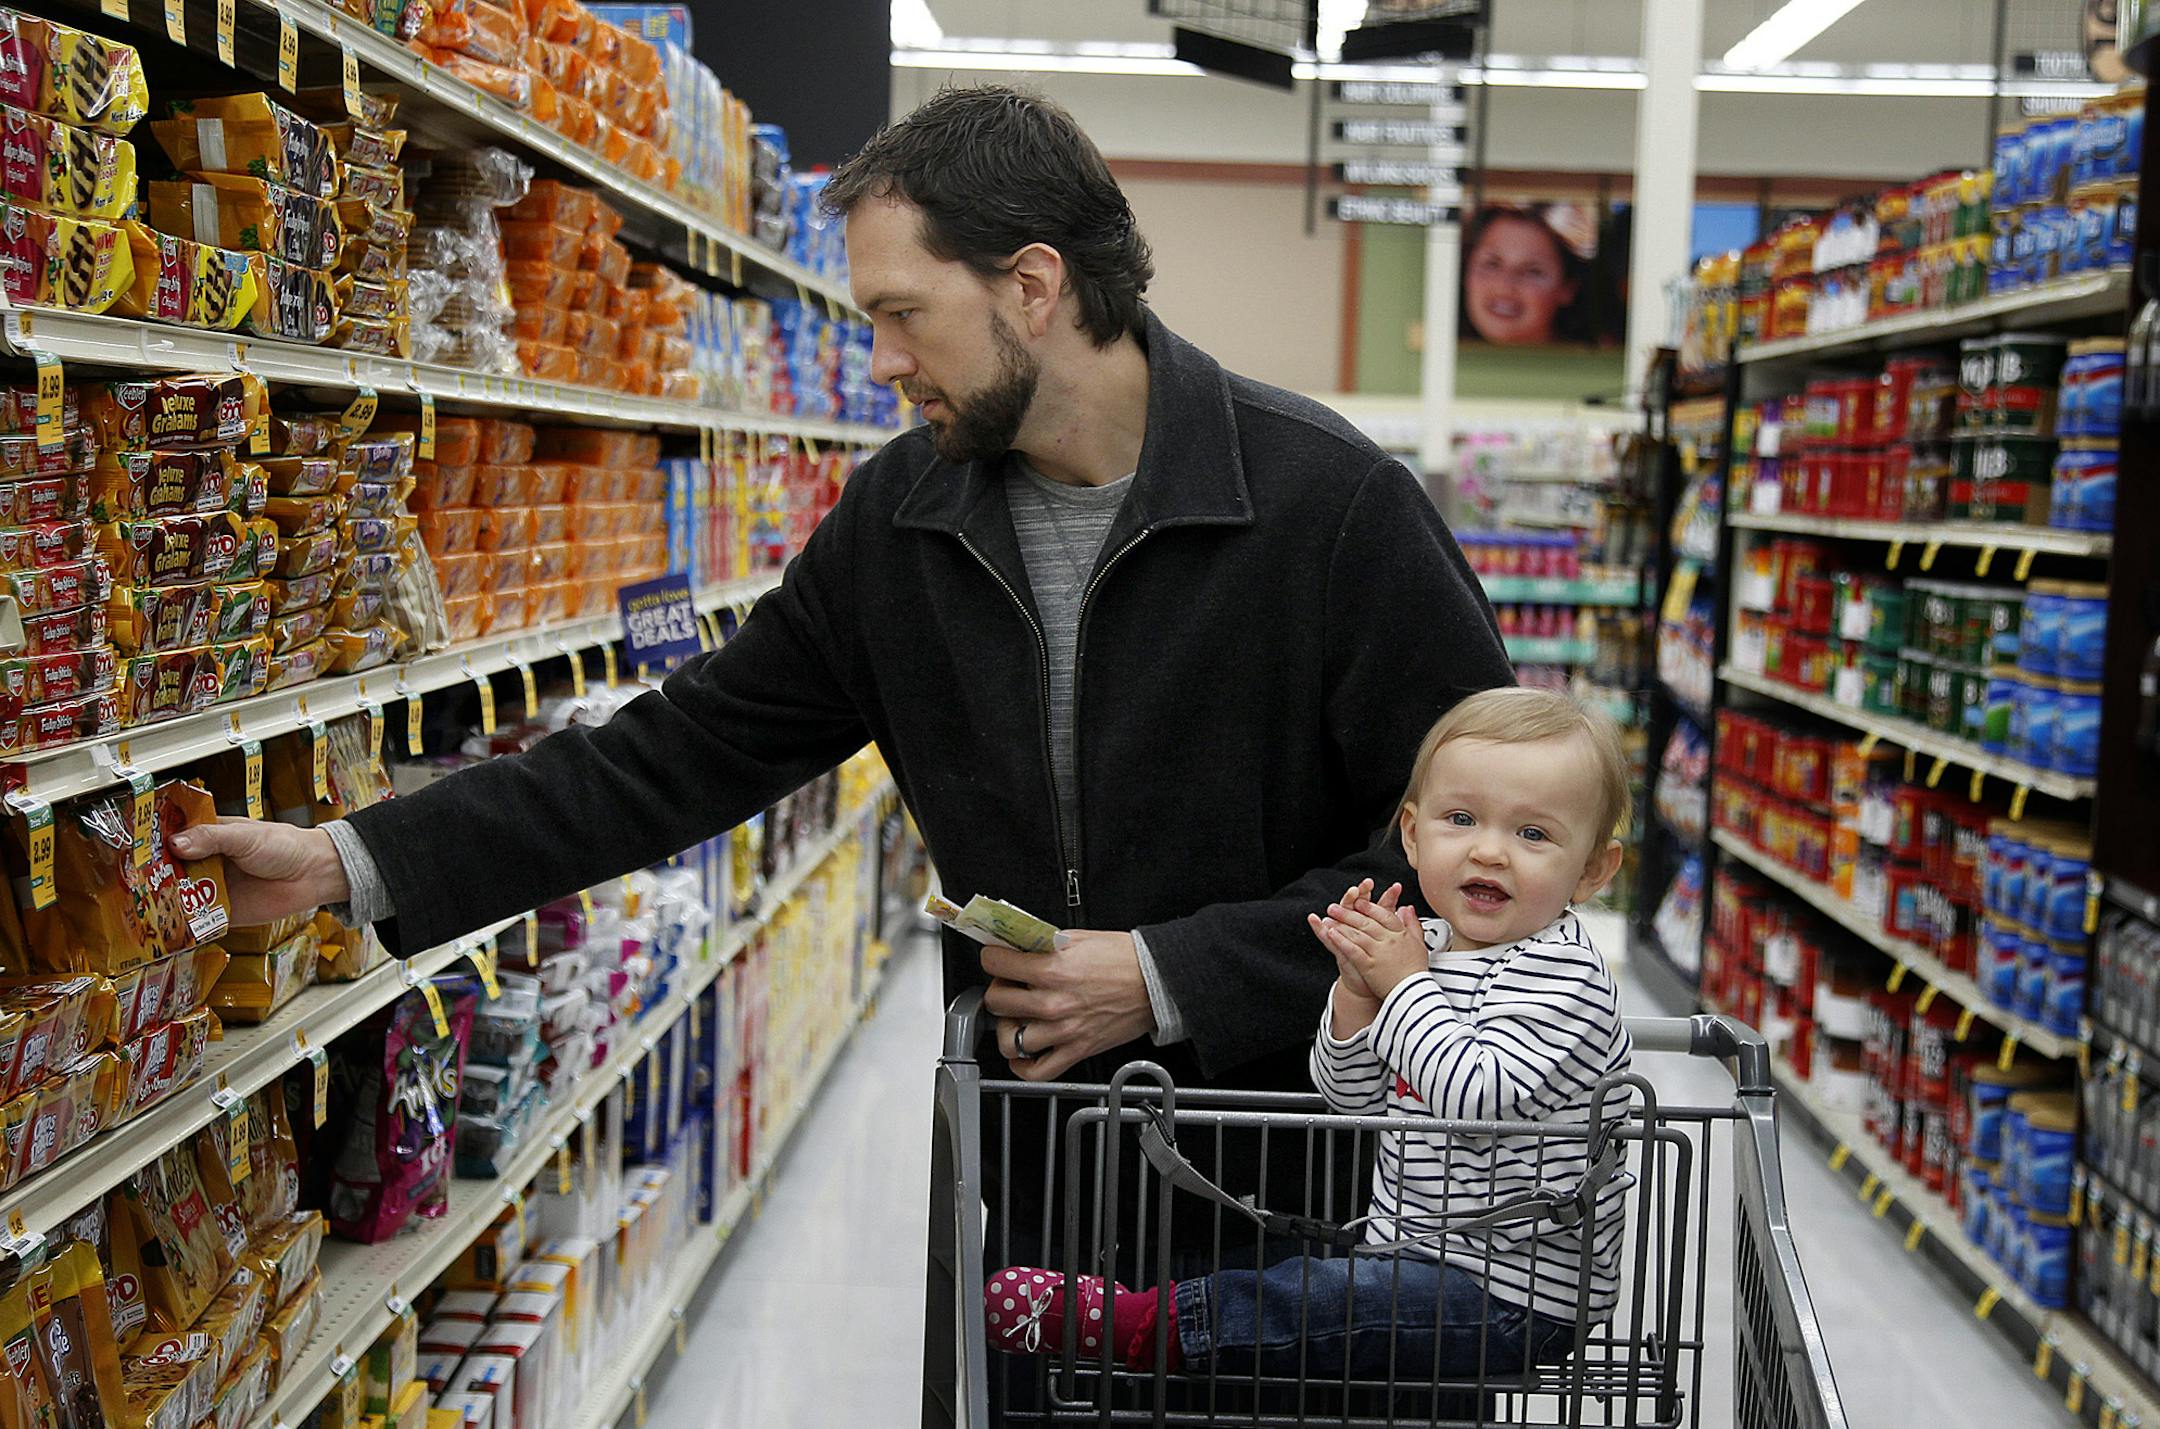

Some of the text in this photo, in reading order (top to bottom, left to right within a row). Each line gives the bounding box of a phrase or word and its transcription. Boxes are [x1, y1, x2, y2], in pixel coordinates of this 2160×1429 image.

[220, 3, 232, 27] 2.99
[282, 32, 296, 56] 2.99
[42, 375, 60, 399] 2.99
[117, 384, 146, 401] Keebler
[161, 394, 196, 414] Deluxe
[349, 403, 374, 421] 2.99
[152, 411, 198, 434] Grahams
[164, 532, 190, 549] Deluxe
[627, 588, 689, 613] gotta love
[627, 601, 692, 633] GREAT
[43, 624, 70, 642] Fudge Sticks
[631, 621, 697, 650] DEALS
[45, 665, 73, 684] Fudge Sticks
[41, 715, 72, 733] Fudge Sticks
[33, 836, 50, 864] 2.99
